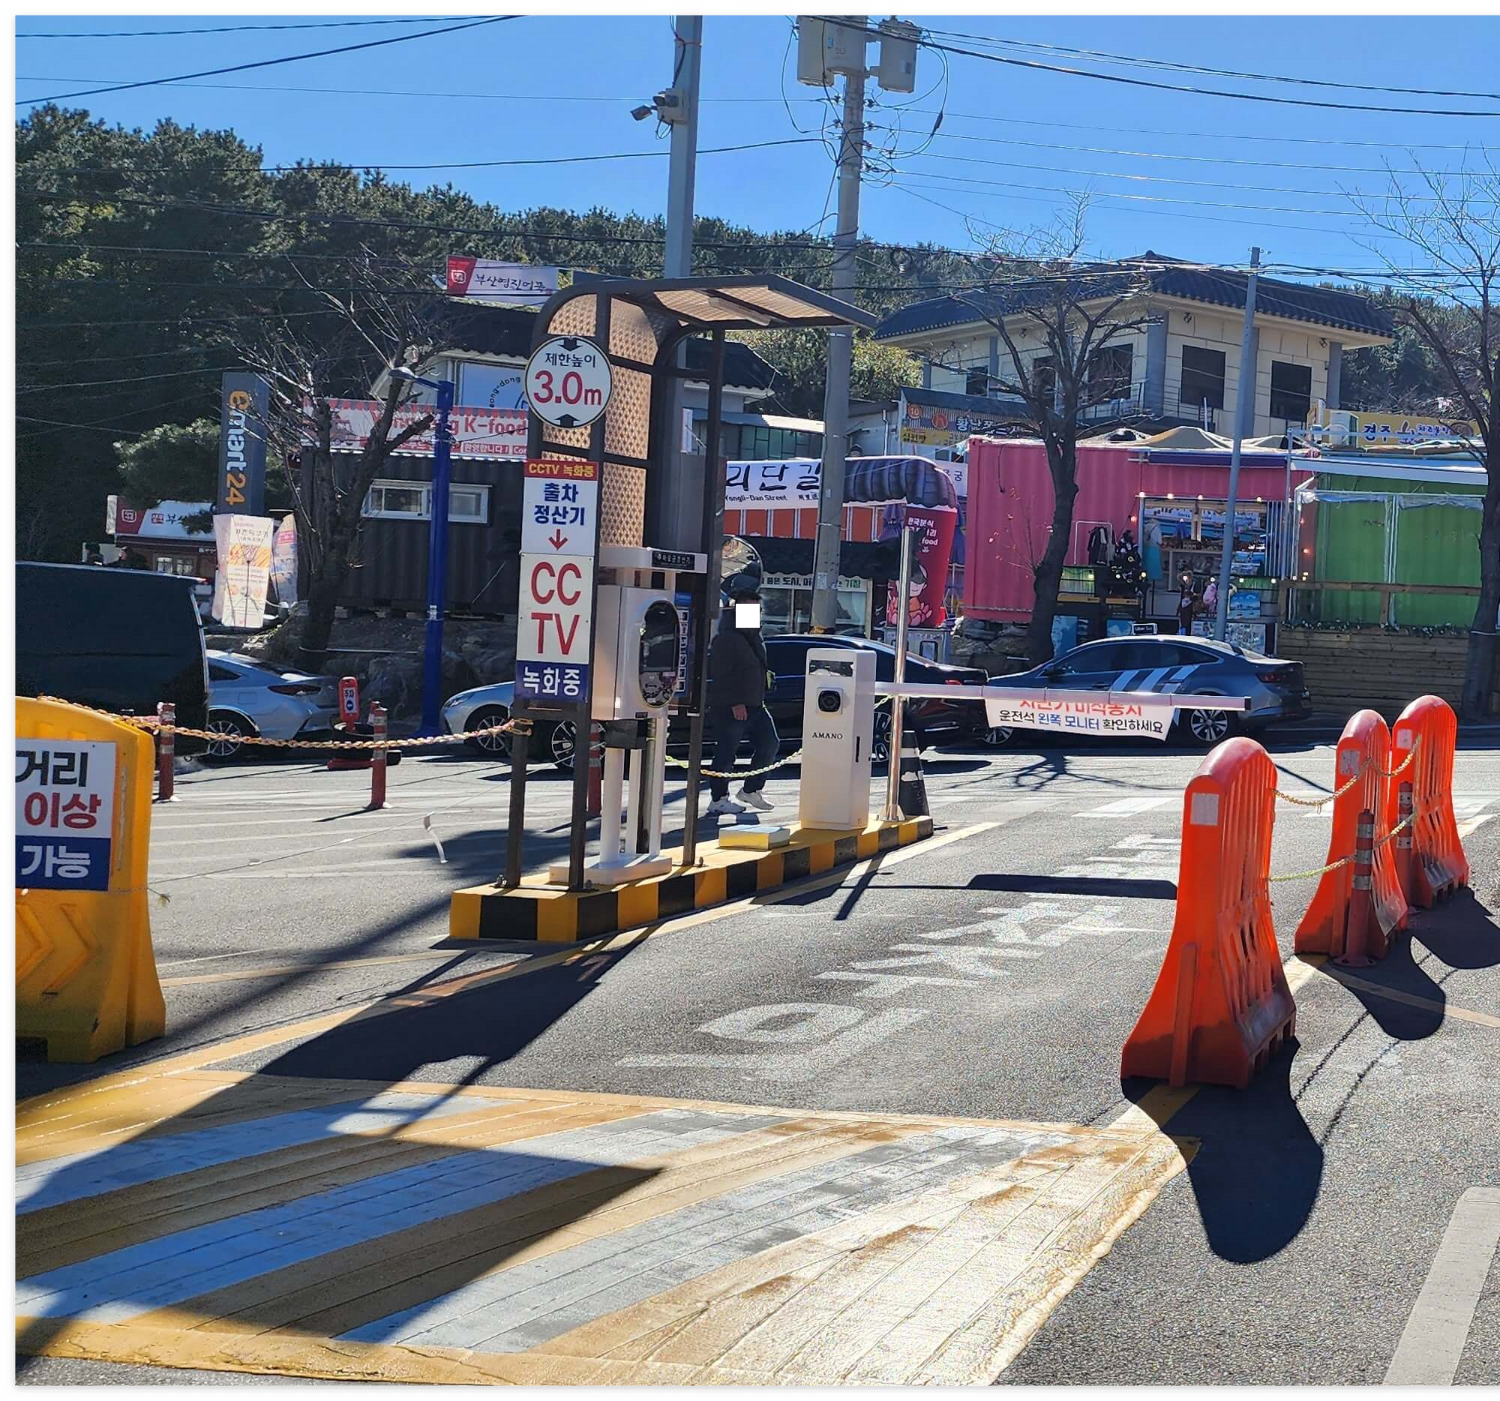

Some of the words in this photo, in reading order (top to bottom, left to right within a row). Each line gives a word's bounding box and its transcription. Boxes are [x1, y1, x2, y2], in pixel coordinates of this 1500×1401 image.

[545, 352, 596, 368] 제한높이
[533, 370, 602, 406] 3.0m
[464, 417, 527, 437] K-food
[528, 463, 560, 475] CCTV
[563, 465, 594, 477] 녹화중
[543, 482, 579, 503] 출차
[533, 504, 586, 526] 정산기
[531, 561, 582, 606] CC
[531, 612, 580, 655] TV
[523, 666, 581, 696] 녹화중
[999, 710, 1035, 723] 운전석
[1038, 713, 1062, 727] 왼쪽
[1065, 716, 1100, 730] 모니터
[1102, 719, 1163, 734] 확인하세요
[812, 732, 843, 740] AMANO
[15, 750, 89, 787] 거리
[24, 791, 102, 829] 이상
[21, 845, 91, 879] 가능
